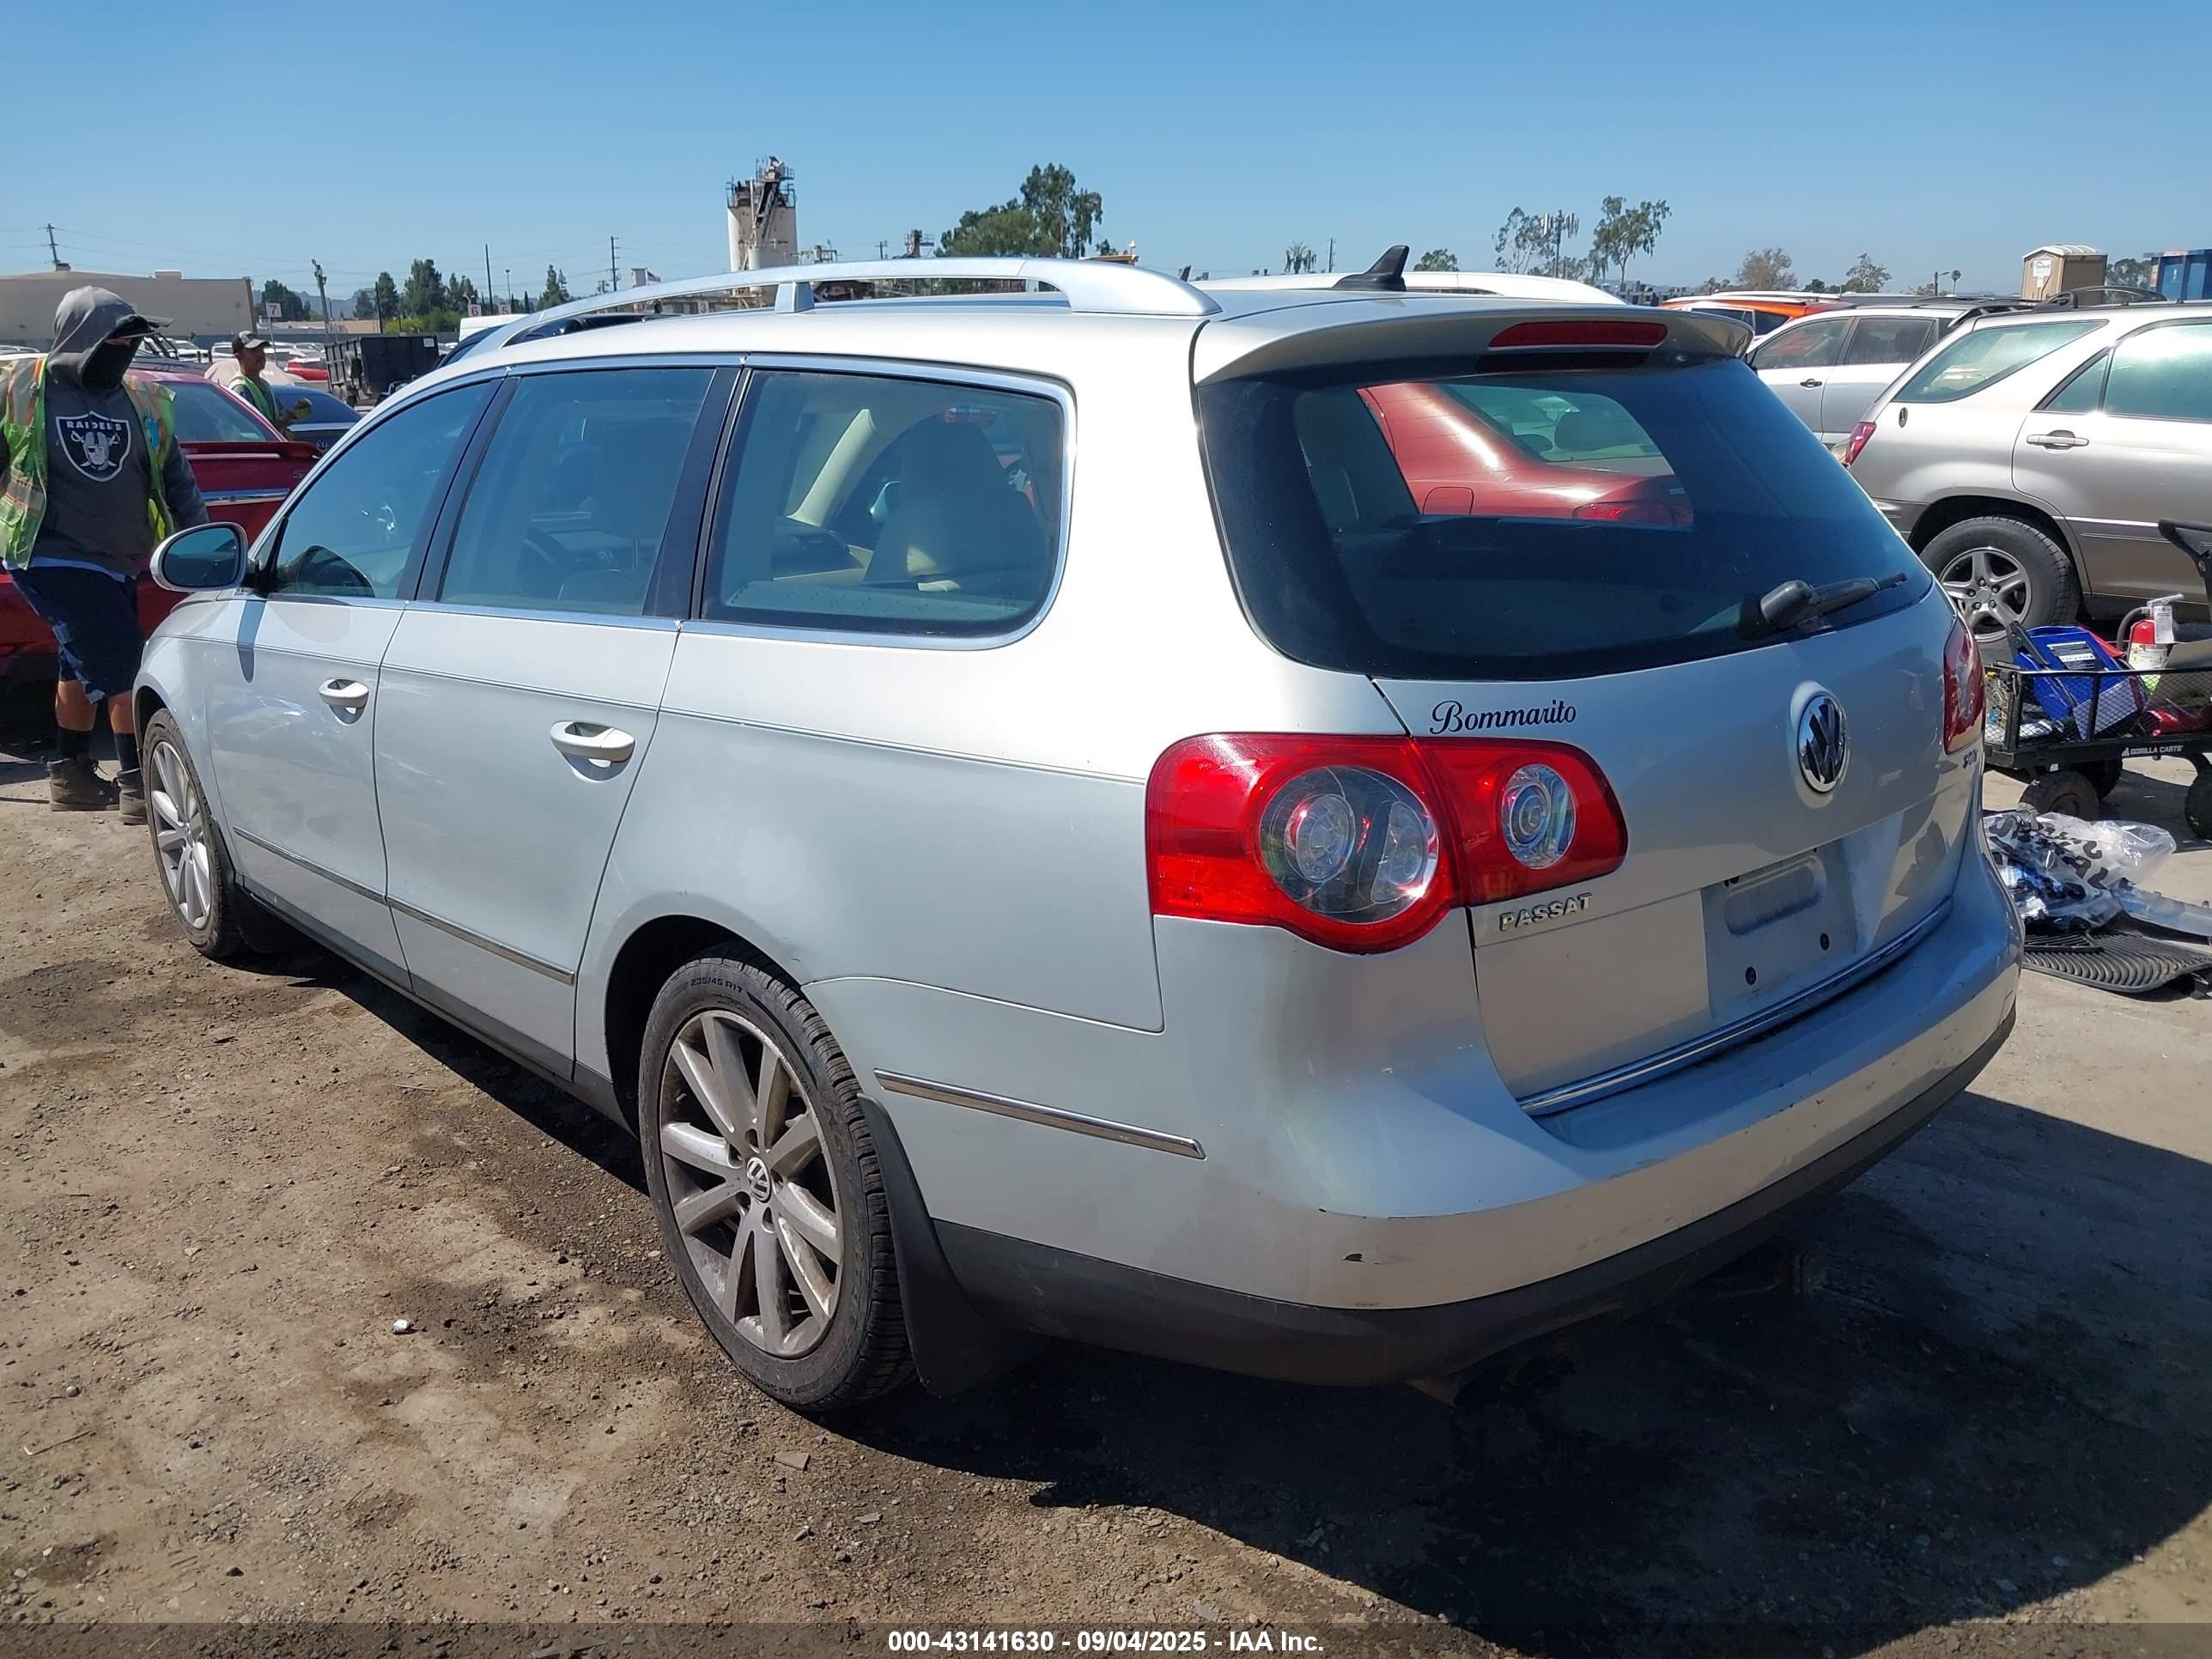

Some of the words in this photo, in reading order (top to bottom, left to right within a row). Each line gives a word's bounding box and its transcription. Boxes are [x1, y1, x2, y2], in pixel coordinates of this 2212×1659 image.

[269, 305, 277, 315] 7
[471, 306, 479, 317] 6
[66, 421, 122, 431] RAIDERS
[1429, 699, 1577, 735] Bommarito
[2130, 746, 2158, 756] GORILLA
[2160, 745, 2183, 754] CARTS
[1499, 892, 1593, 932] PASSAT
